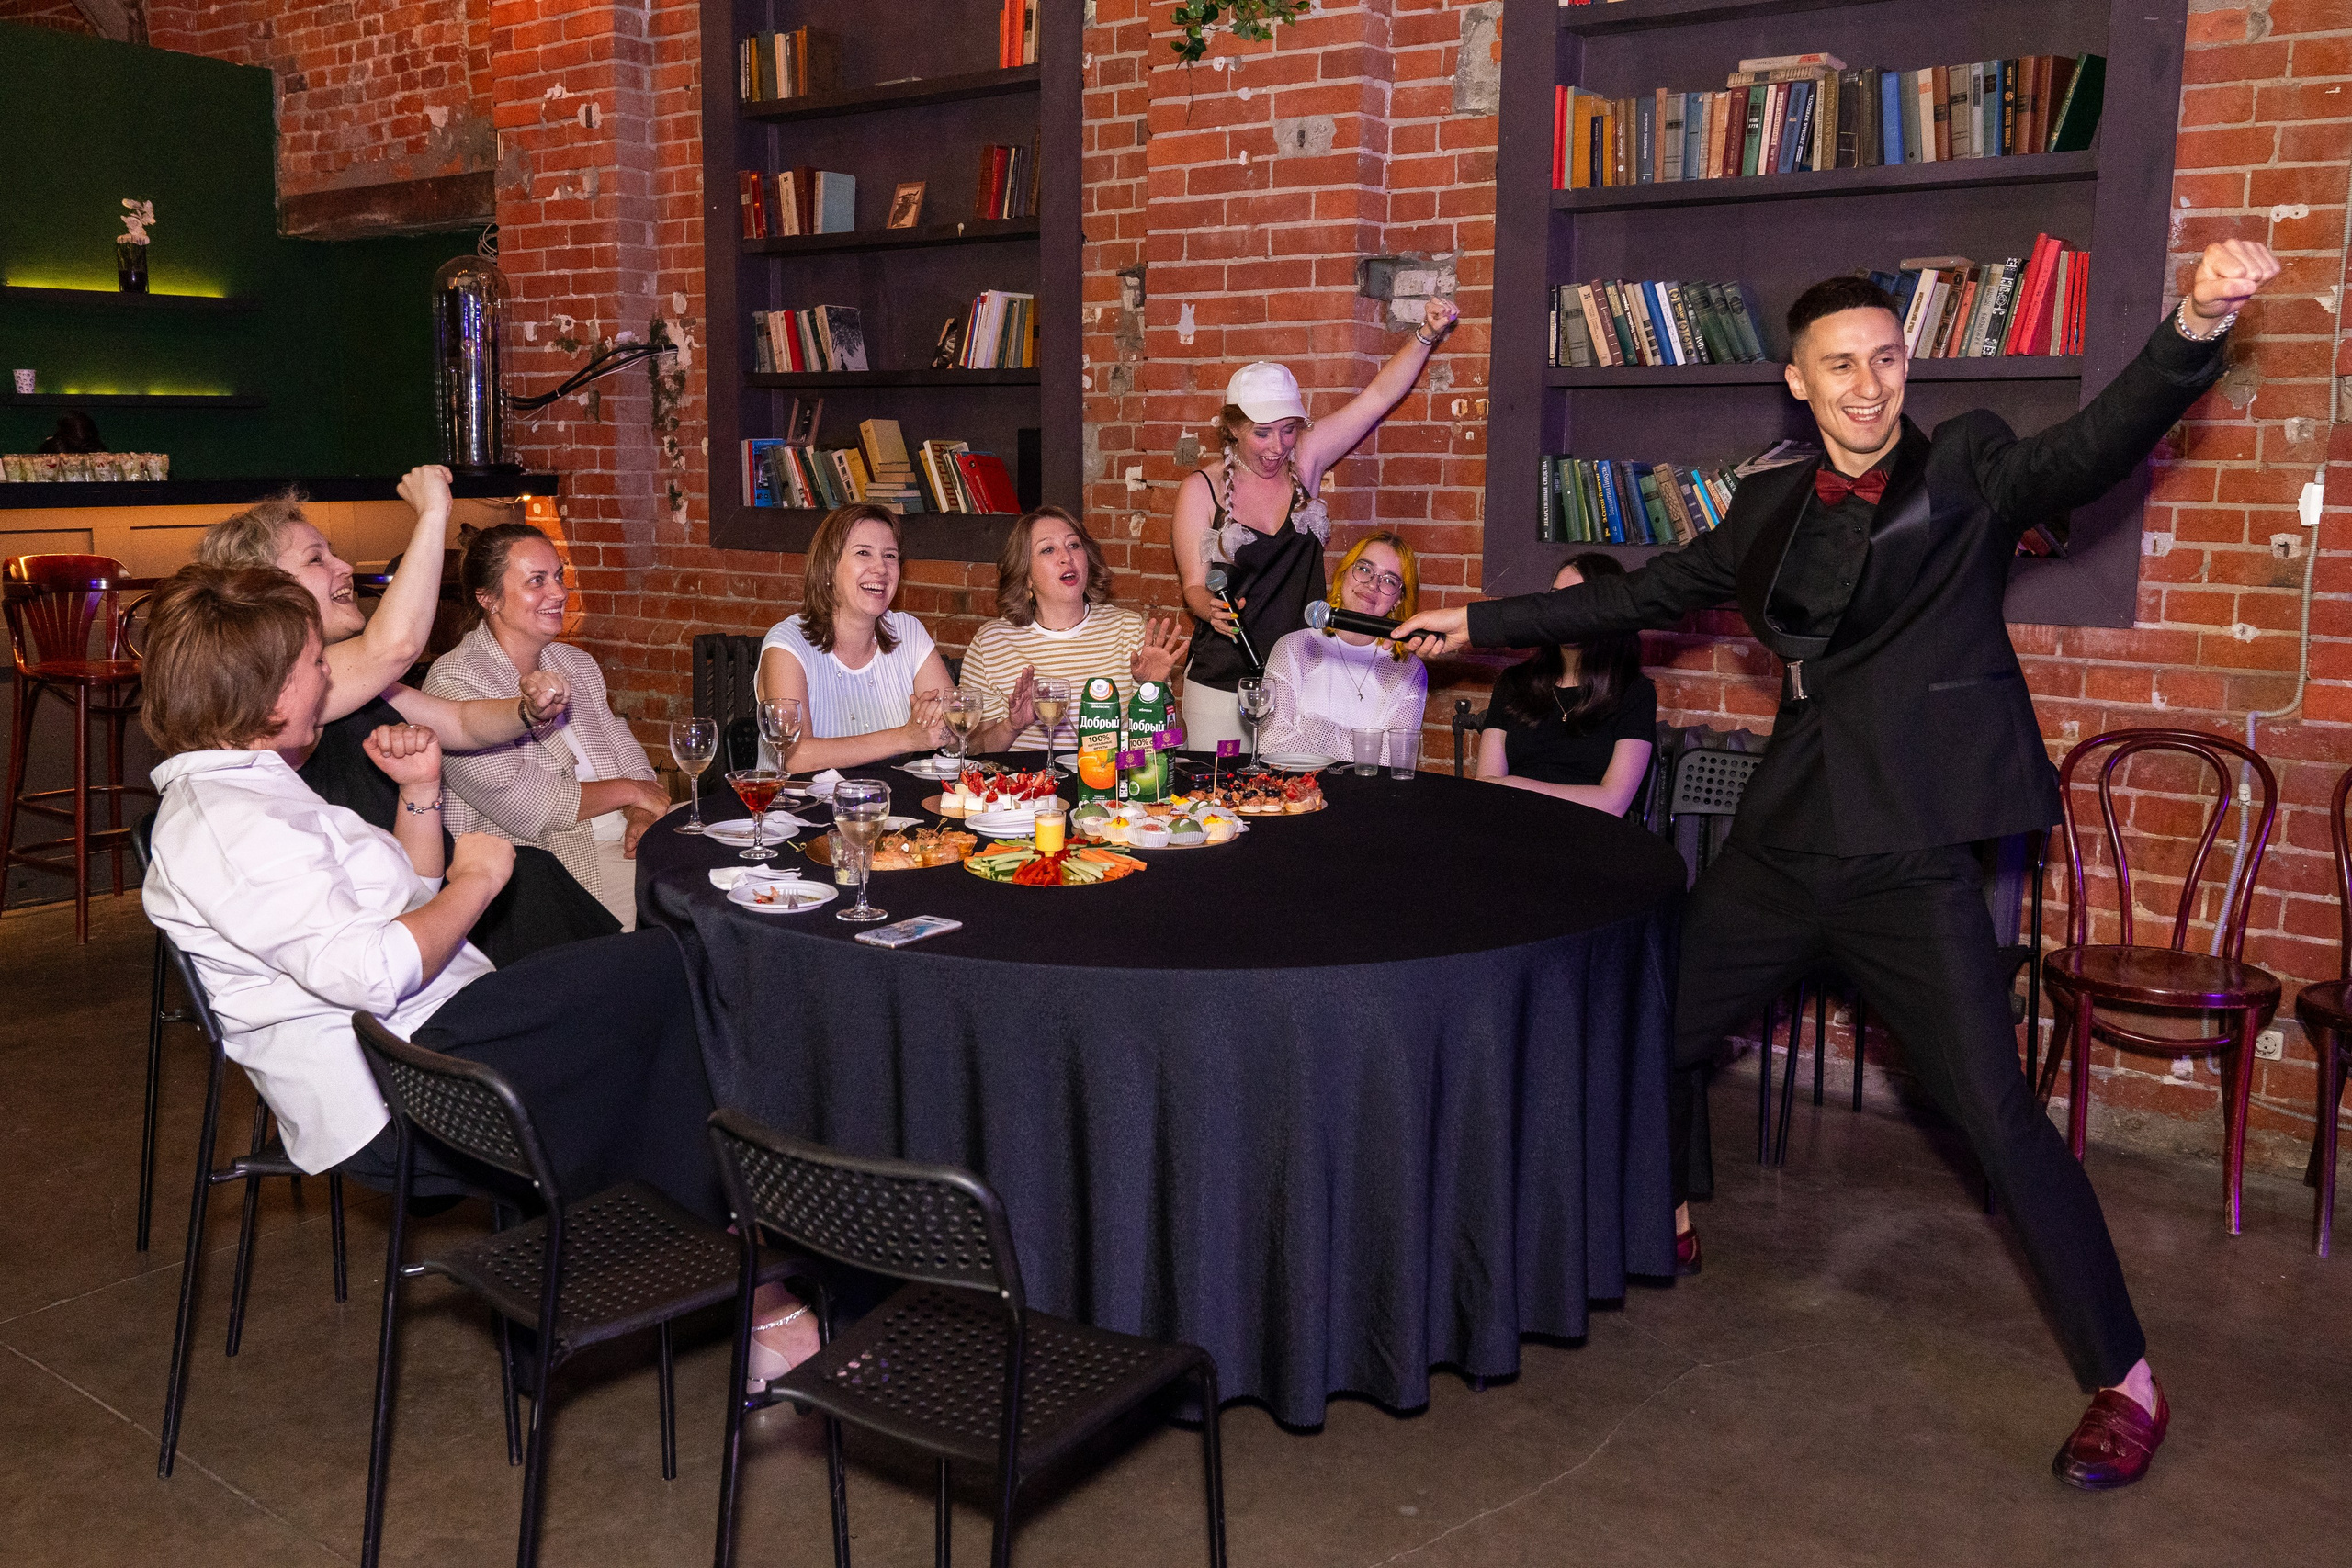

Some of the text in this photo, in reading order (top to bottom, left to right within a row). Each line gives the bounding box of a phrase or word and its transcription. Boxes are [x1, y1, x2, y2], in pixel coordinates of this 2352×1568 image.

[1080, 716, 1120, 729] Добрый
[1129, 718, 1165, 733] Добрый
[1088, 734, 1111, 744] 100%
[1129, 739, 1148, 747] 100%
